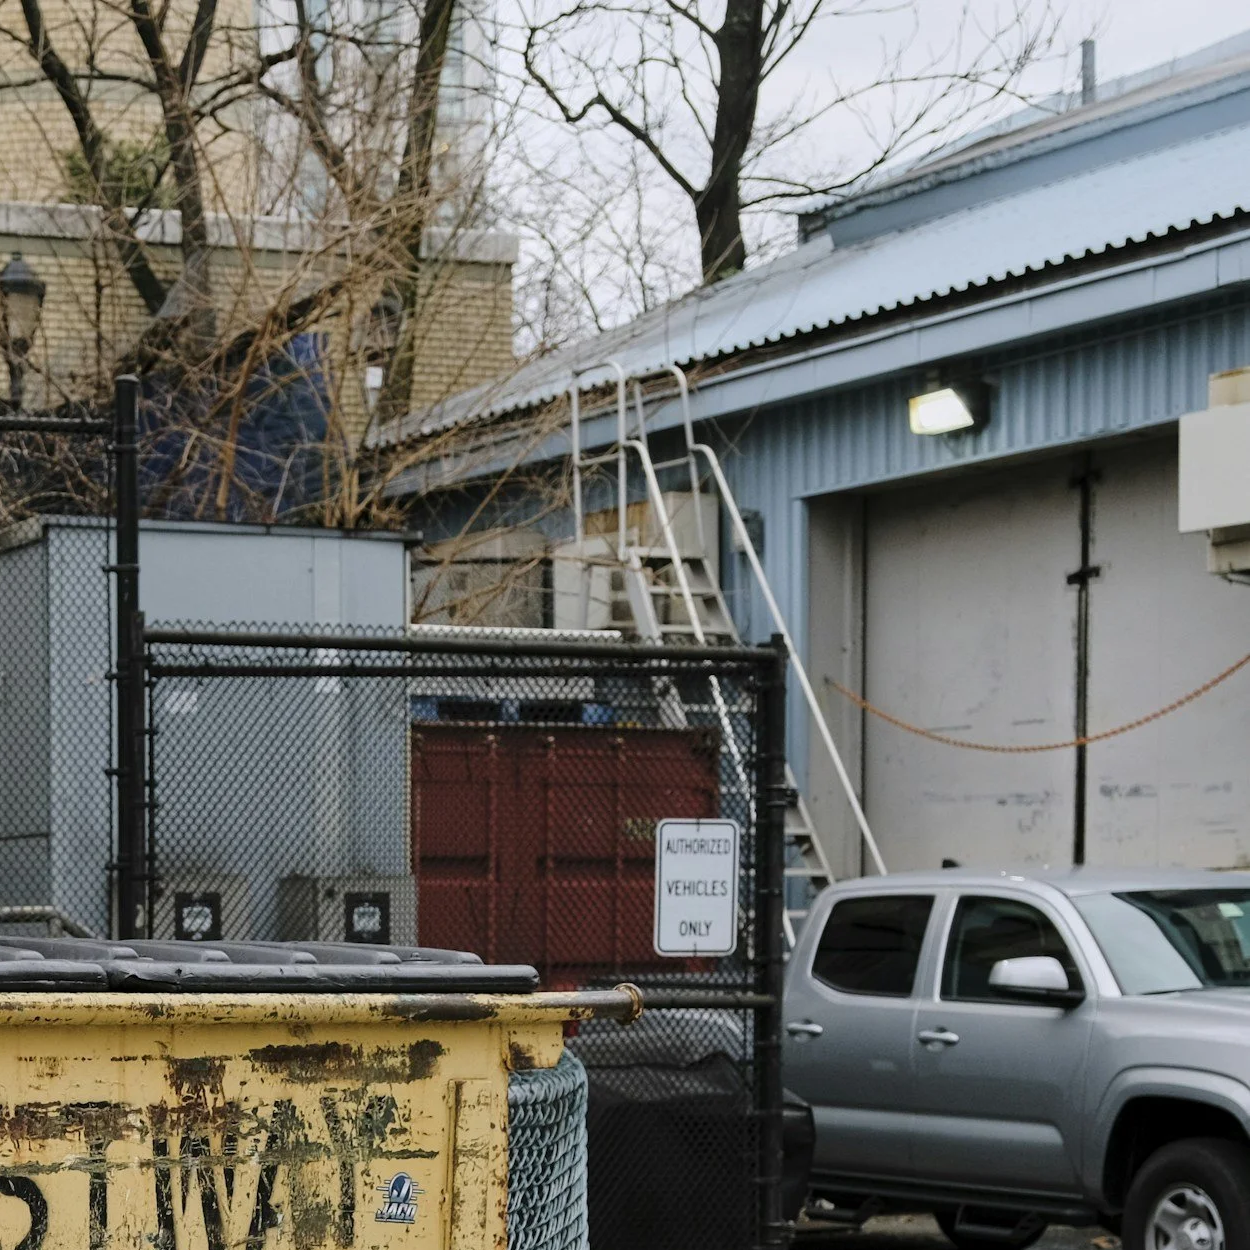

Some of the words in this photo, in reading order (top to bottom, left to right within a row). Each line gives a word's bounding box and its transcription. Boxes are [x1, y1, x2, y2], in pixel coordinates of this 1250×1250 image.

[665, 838, 731, 855] AUTHORIZED
[666, 880, 728, 897] VEHICLES
[679, 920, 712, 937] ONLY
